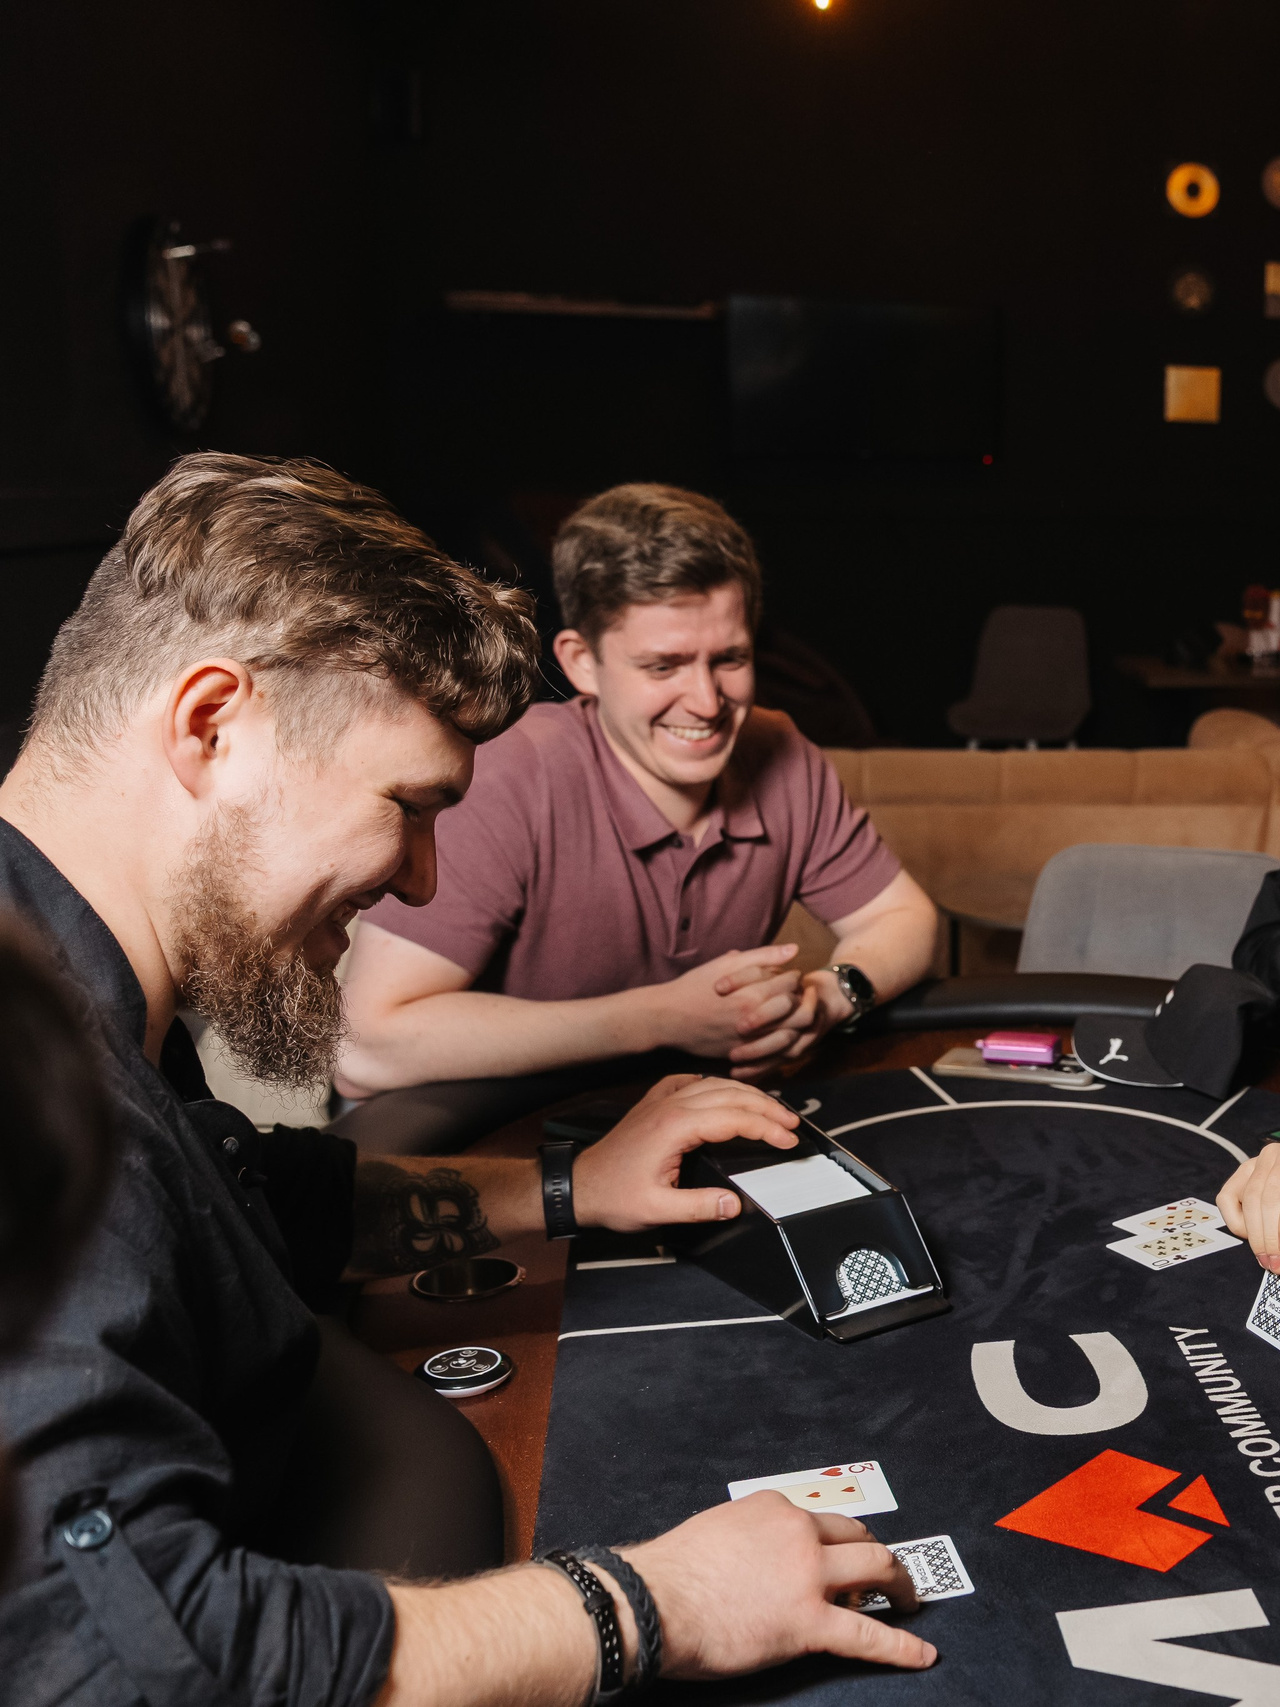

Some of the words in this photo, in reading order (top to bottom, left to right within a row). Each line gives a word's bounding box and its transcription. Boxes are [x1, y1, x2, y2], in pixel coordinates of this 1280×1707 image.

[1176, 1220, 1197, 1229] 10
[1151, 1259, 1174, 1269] 10
[847, 1462, 876, 1475] 3
